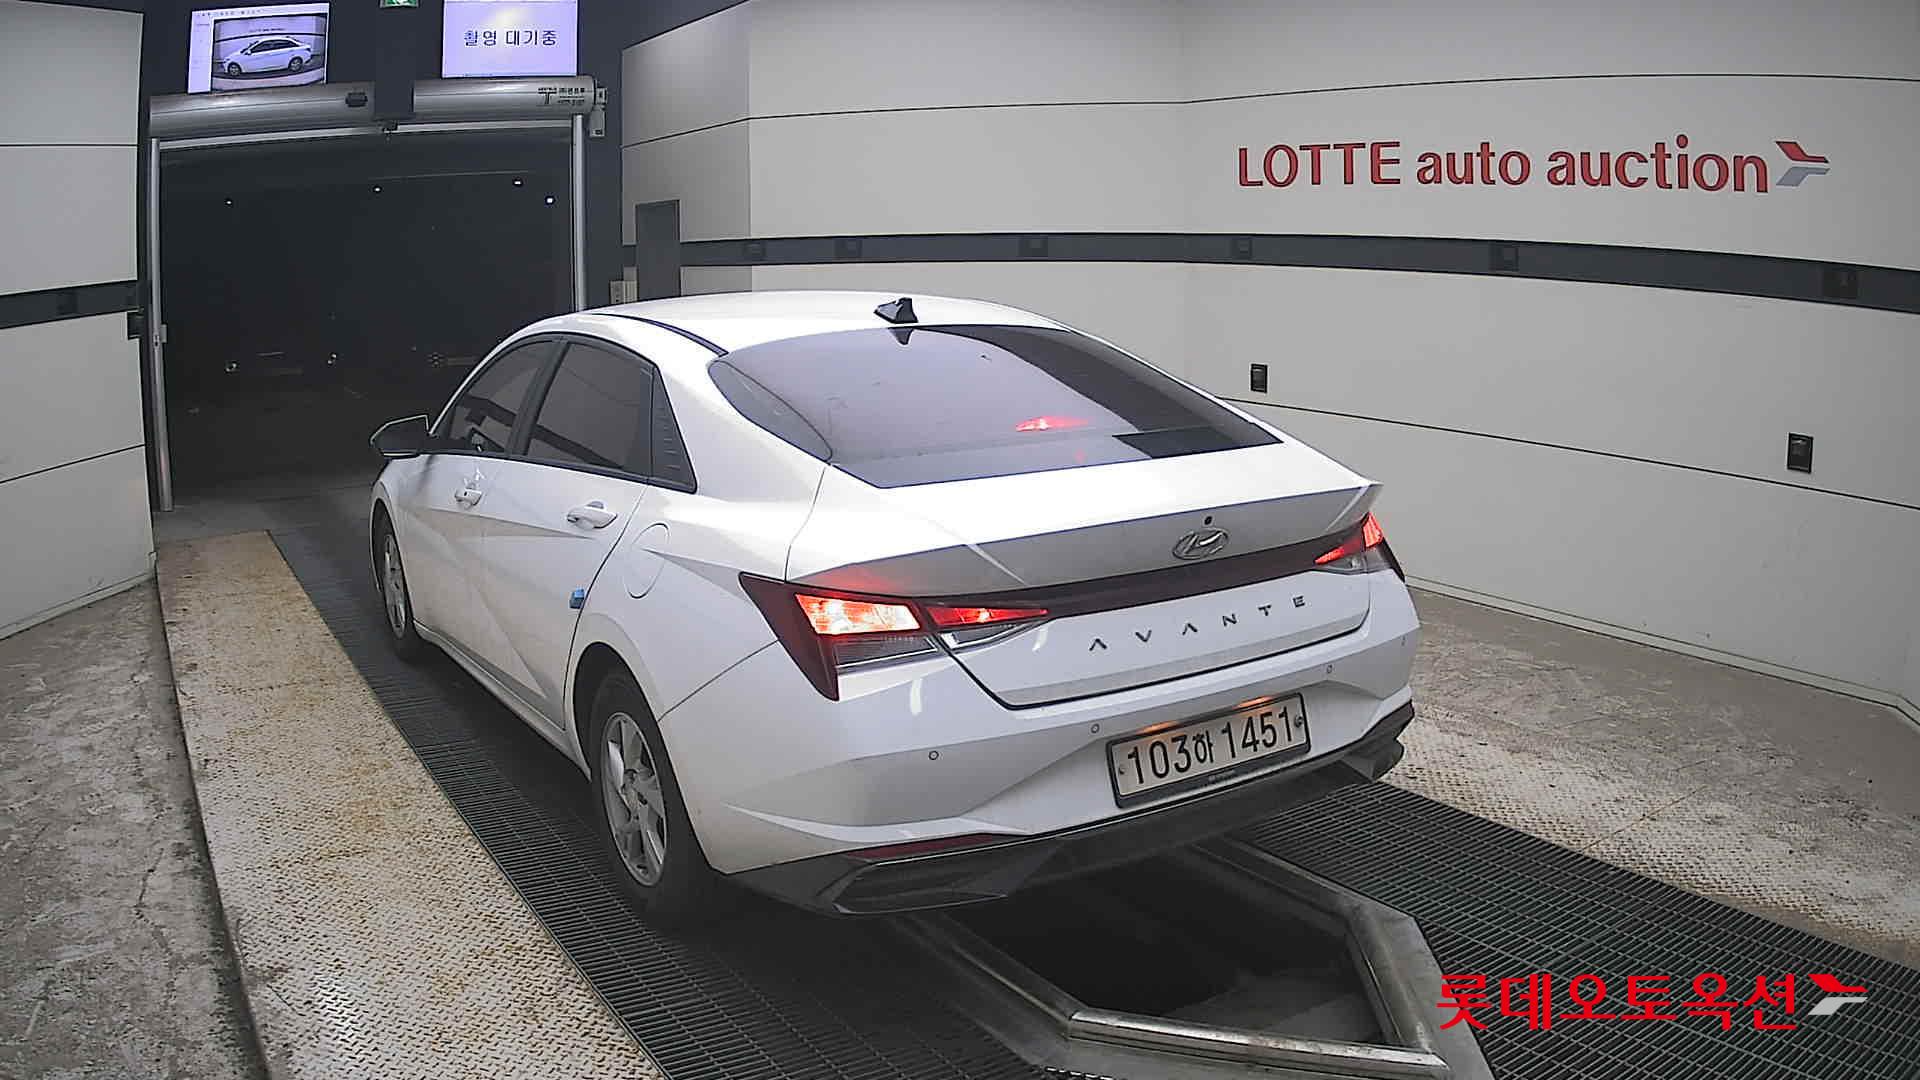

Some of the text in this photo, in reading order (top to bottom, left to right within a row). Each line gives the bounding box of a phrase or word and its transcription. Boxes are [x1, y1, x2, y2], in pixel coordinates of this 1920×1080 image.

[464, 29, 557, 46] 촬영 대기중
[1238, 135, 1769, 193] LOTTE auto auction
[1088, 595, 1306, 651] AVANTE
[1127, 705, 1293, 785] 103하 1451
